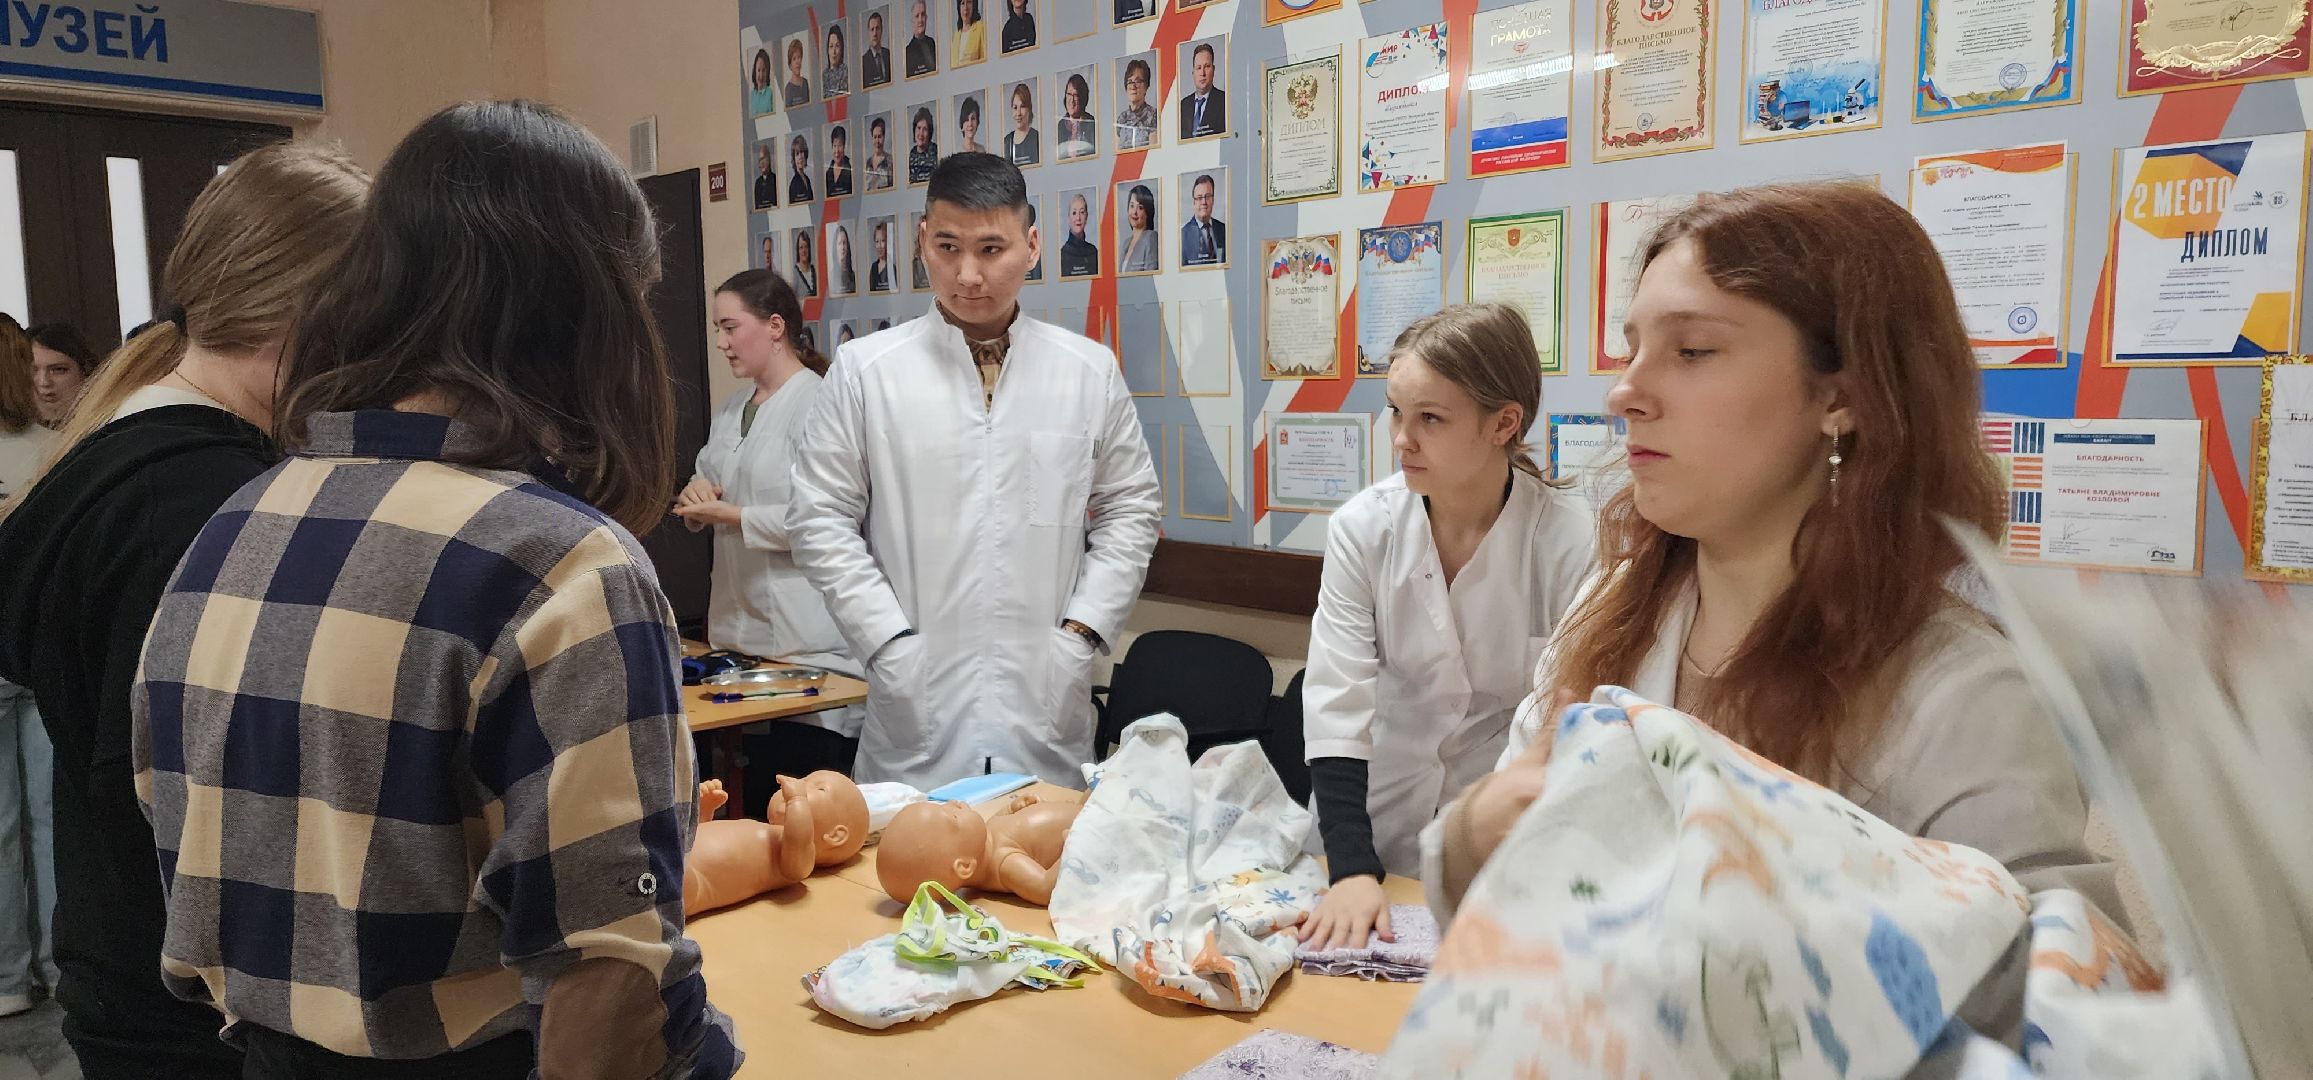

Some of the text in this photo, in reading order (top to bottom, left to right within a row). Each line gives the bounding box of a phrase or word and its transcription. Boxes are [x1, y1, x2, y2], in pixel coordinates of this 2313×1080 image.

[1490, 24, 1552, 47] ГРАМОТА
[1616, 26, 1696, 46] БЛАГОДАРСТВЕННОЕ
[1639, 38, 1672, 49] ПИСЬМО
[711, 175, 723, 190] 200
[2133, 183, 2148, 219] 2
[2154, 175, 2233, 217] МЕСТО
[2180, 227, 2268, 263] ДИПЛОМ
[2076, 455, 2144, 463] БЛАГОДАРНОСТЬ
[2086, 495, 2130, 504] КОЗЛОВОЙ
[2092, 489, 2160, 498] ВЛАДИМИРОВНЕ
